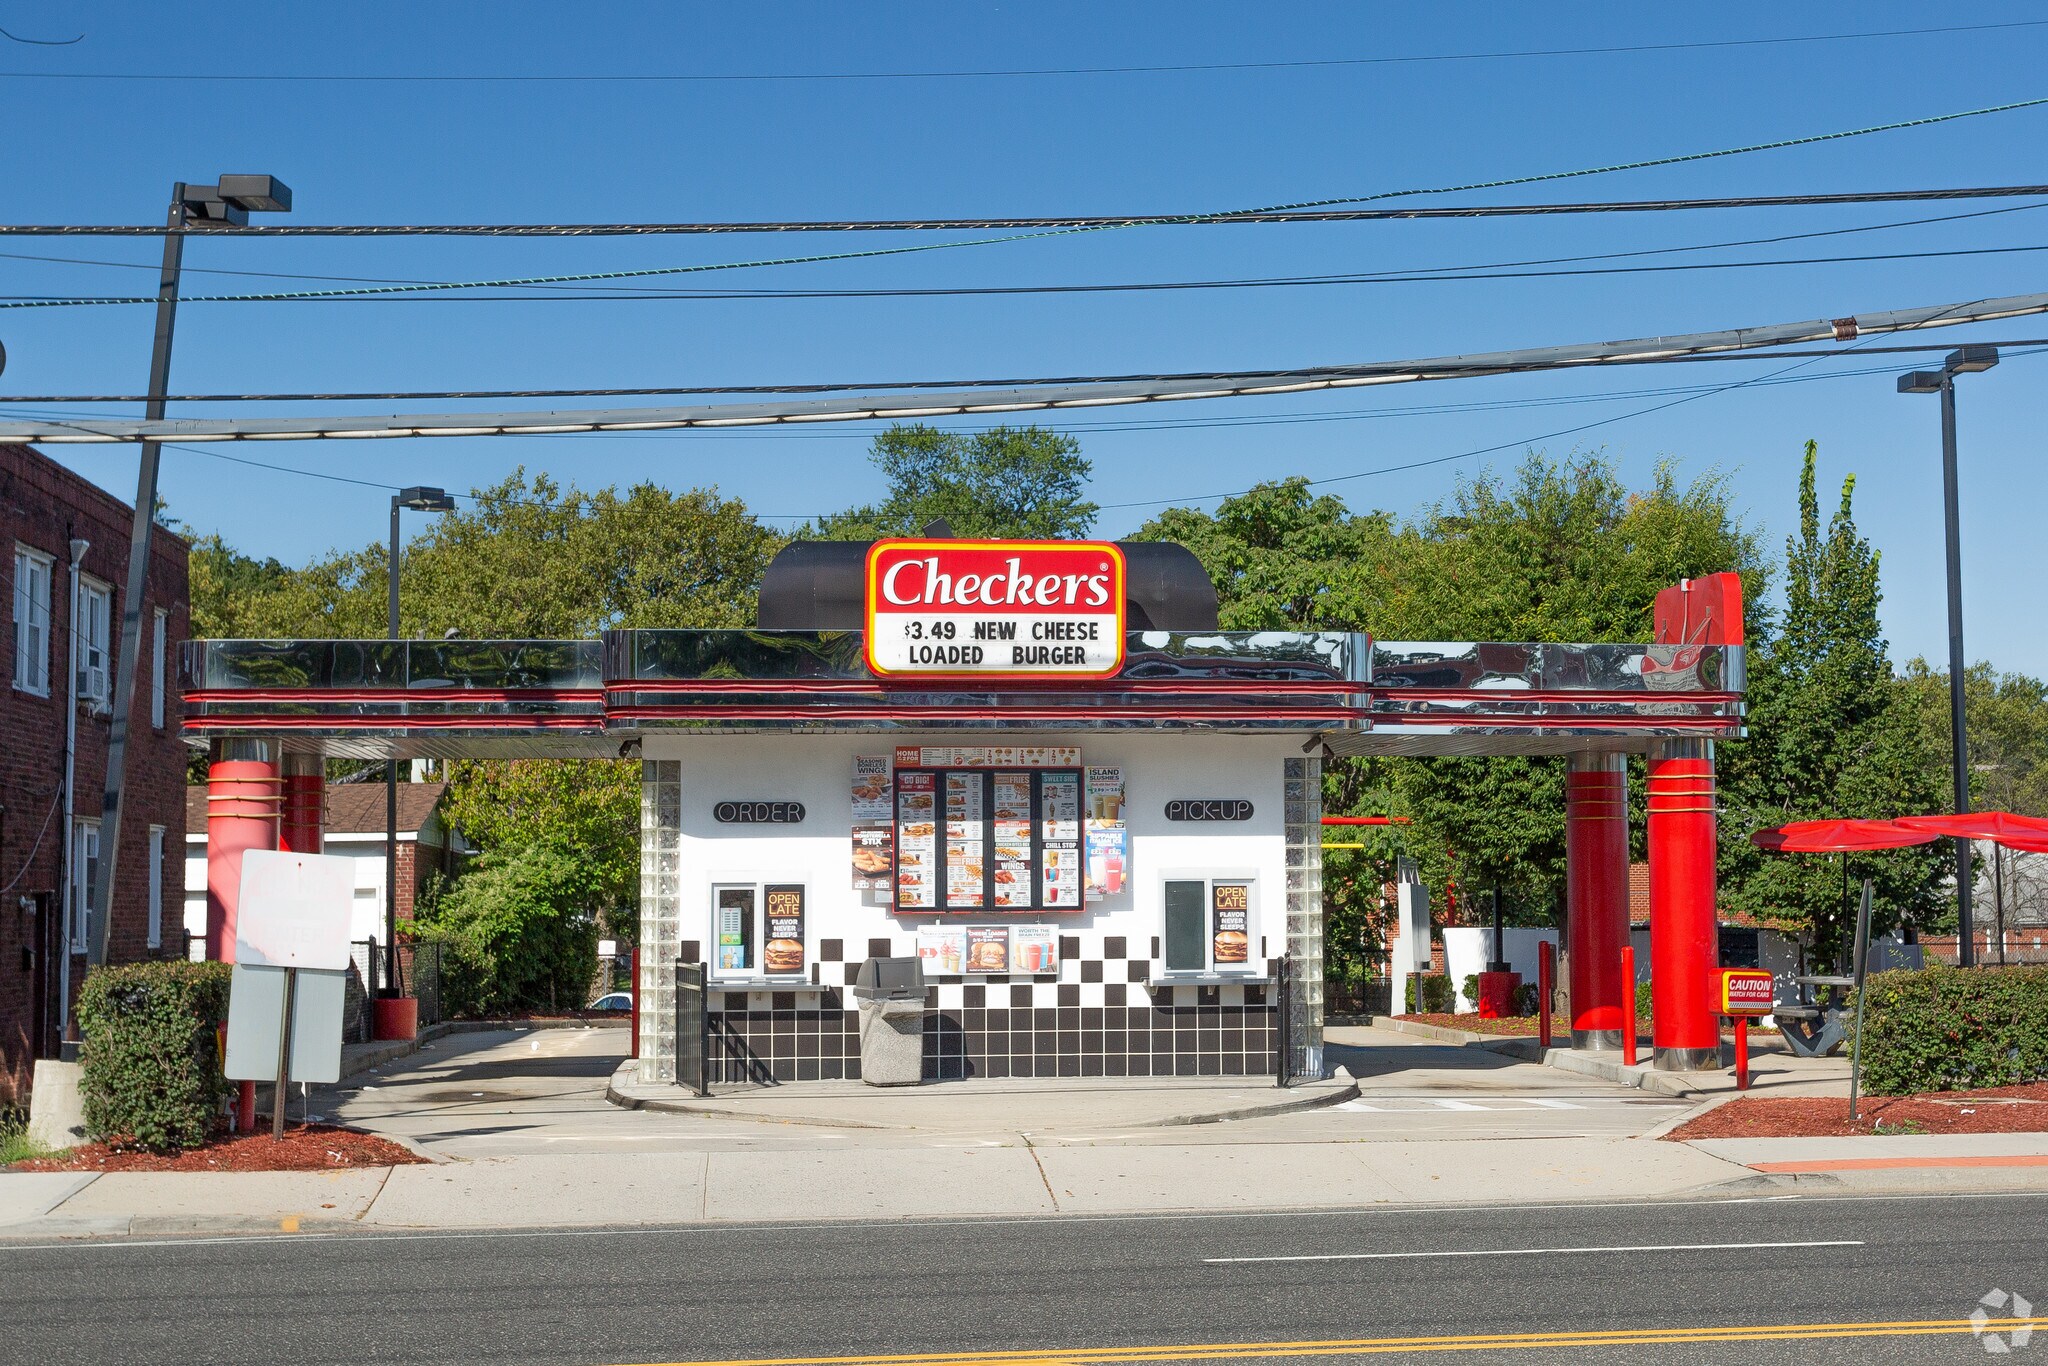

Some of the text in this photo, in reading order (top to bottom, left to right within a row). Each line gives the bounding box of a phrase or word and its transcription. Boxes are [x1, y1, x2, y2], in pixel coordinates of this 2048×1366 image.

[882, 557, 1109, 606] Checkers
[904, 621, 1098, 641] $3.49 NEW CHEESE
[909, 645, 1086, 665] LOADED BURGER
[904, 775, 930, 784] GO BIG!
[1009, 776, 1030, 784] FRIES
[718, 802, 801, 822] ORDER
[1169, 801, 1250, 820] PICK-UP
[961, 857, 982, 865] FRIES
[1000, 862, 1026, 870] WINGS
[1216, 887, 1247, 897] OPEN
[768, 894, 800, 905] OPEN
[1216, 896, 1247, 908] LATE
[768, 903, 800, 915] LATE
[771, 918, 798, 926] FLAVOR
[1729, 979, 1771, 991] CAUTION
